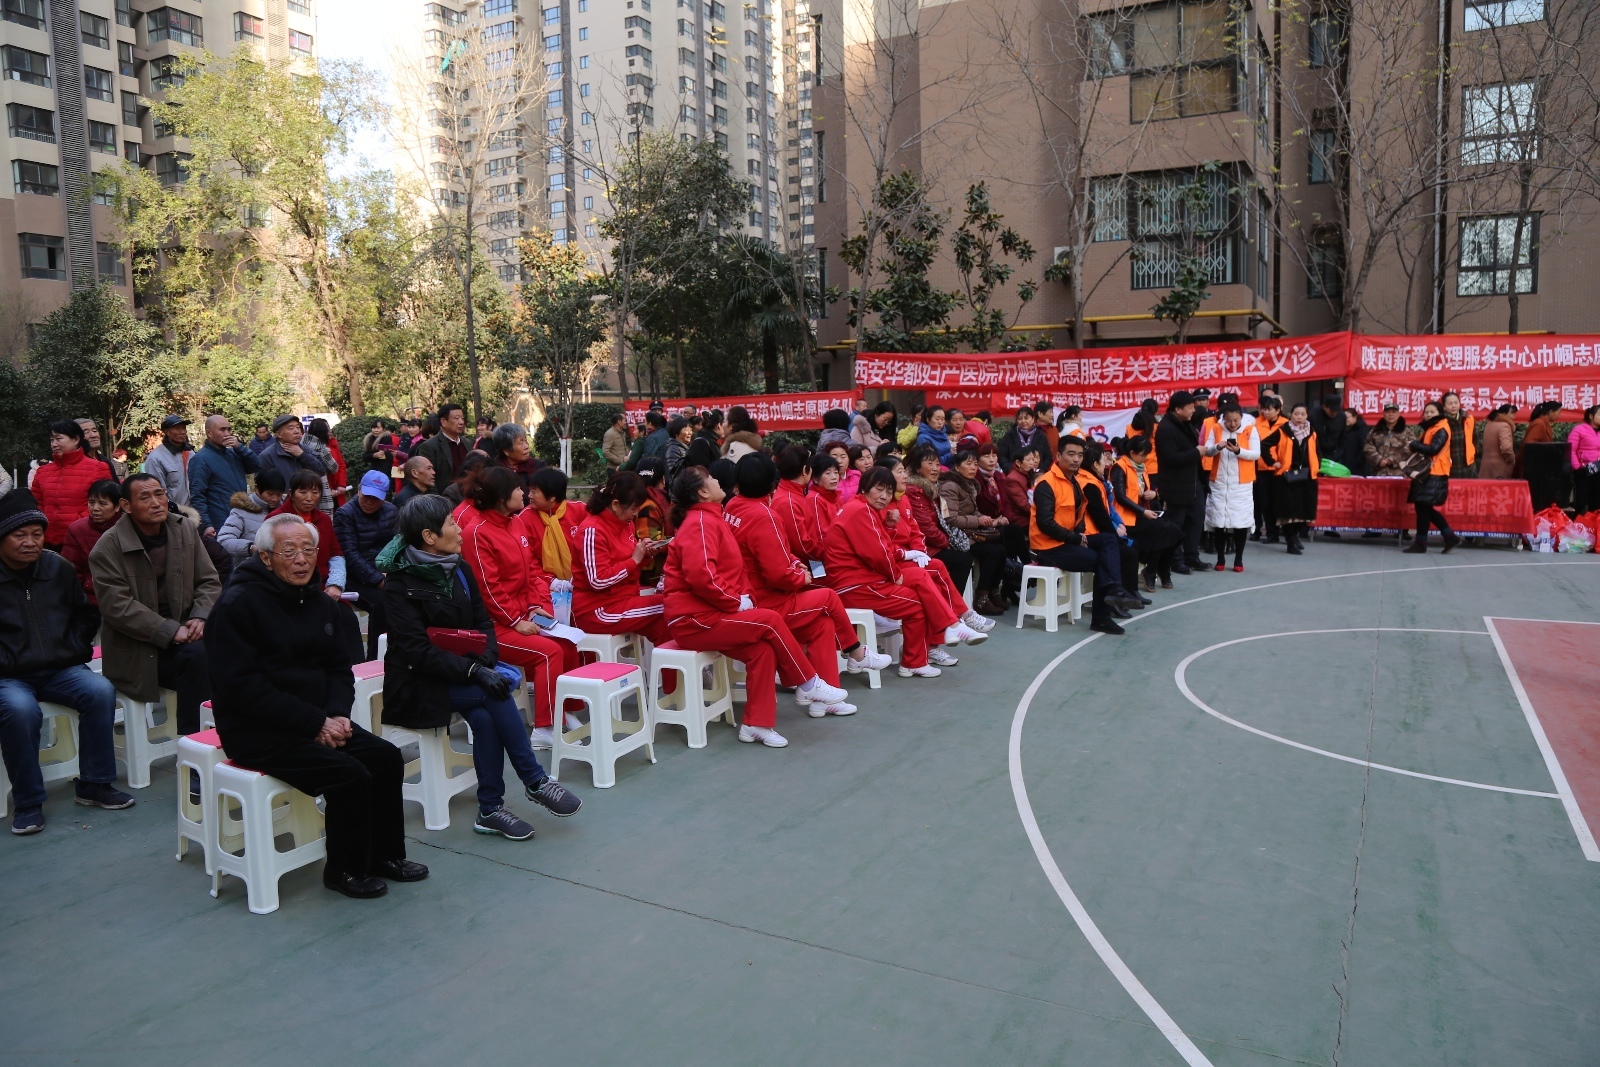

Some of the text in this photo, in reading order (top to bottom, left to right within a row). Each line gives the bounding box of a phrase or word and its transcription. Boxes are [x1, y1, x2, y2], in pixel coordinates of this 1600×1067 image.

[855, 343, 1317, 387] 西安华都妇产医院巾帼志愿服务关爱健康社区义诊
